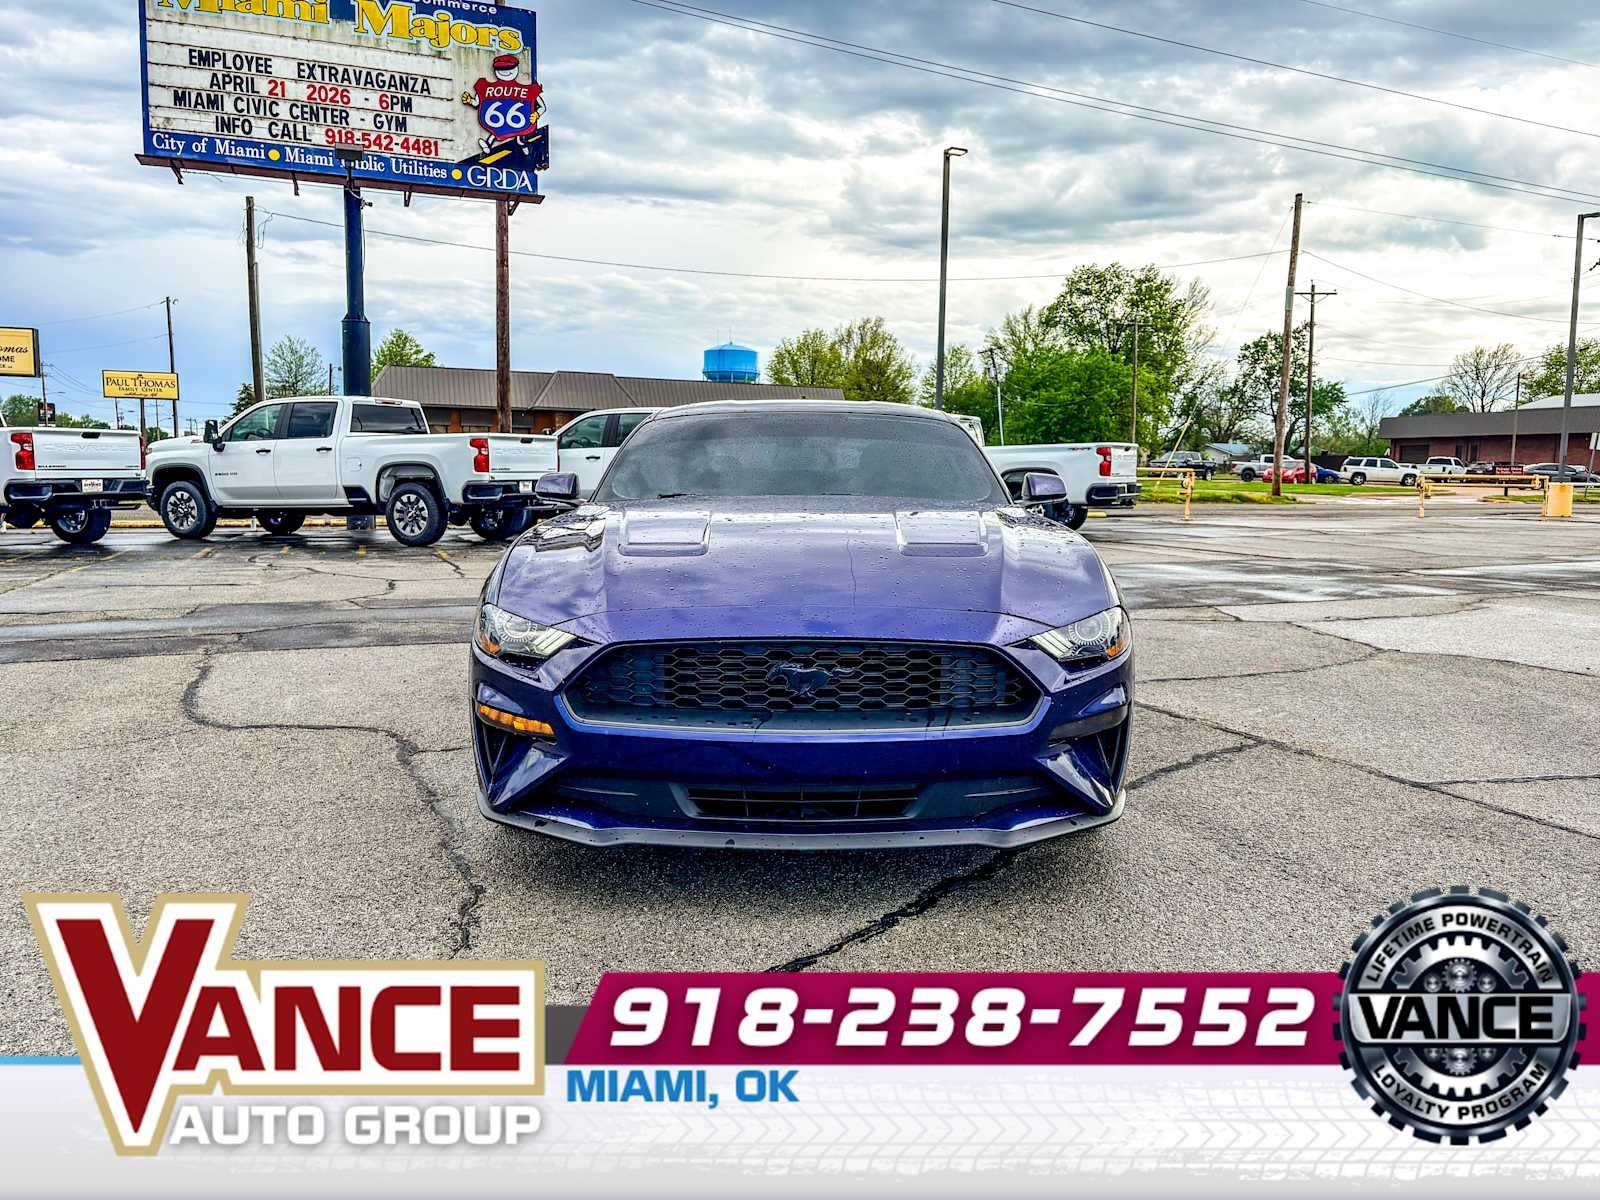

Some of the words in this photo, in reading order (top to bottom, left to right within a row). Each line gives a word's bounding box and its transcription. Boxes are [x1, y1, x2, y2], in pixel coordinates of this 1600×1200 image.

[412, 0, 497, 14] mmerce
[354, 0, 522, 50] Majors
[188, 48, 273, 75] EMPLOYEE
[297, 62, 431, 95] EXTRAVAGANZA
[209, 72, 260, 94] APRIL
[267, 79, 286, 98] 21
[306, 84, 351, 105] 2026
[378, 93, 413, 113] 6PM
[485, 86, 528, 99] ROUTE
[173, 90, 225, 112] MIAMI
[233, 96, 280, 117] CIVIC
[289, 103, 350, 126] CENTER
[373, 113, 408, 133] GYM
[484, 102, 526, 129] 66
[152, 133, 187, 155] City
[191, 138, 208, 153] of
[214, 139, 266, 160] Miami
[215, 115, 253, 135] INFO
[268, 121, 312, 142] CALL
[325, 128, 439, 157] 918-542-4481
[284, 146, 334, 167] Miami
[390, 157, 448, 179] Utilities
[467, 165, 532, 191] GRDA
[0, 355, 15, 363] ME
[106, 376, 130, 387] PAUL
[131, 378, 176, 389] THOMAS
